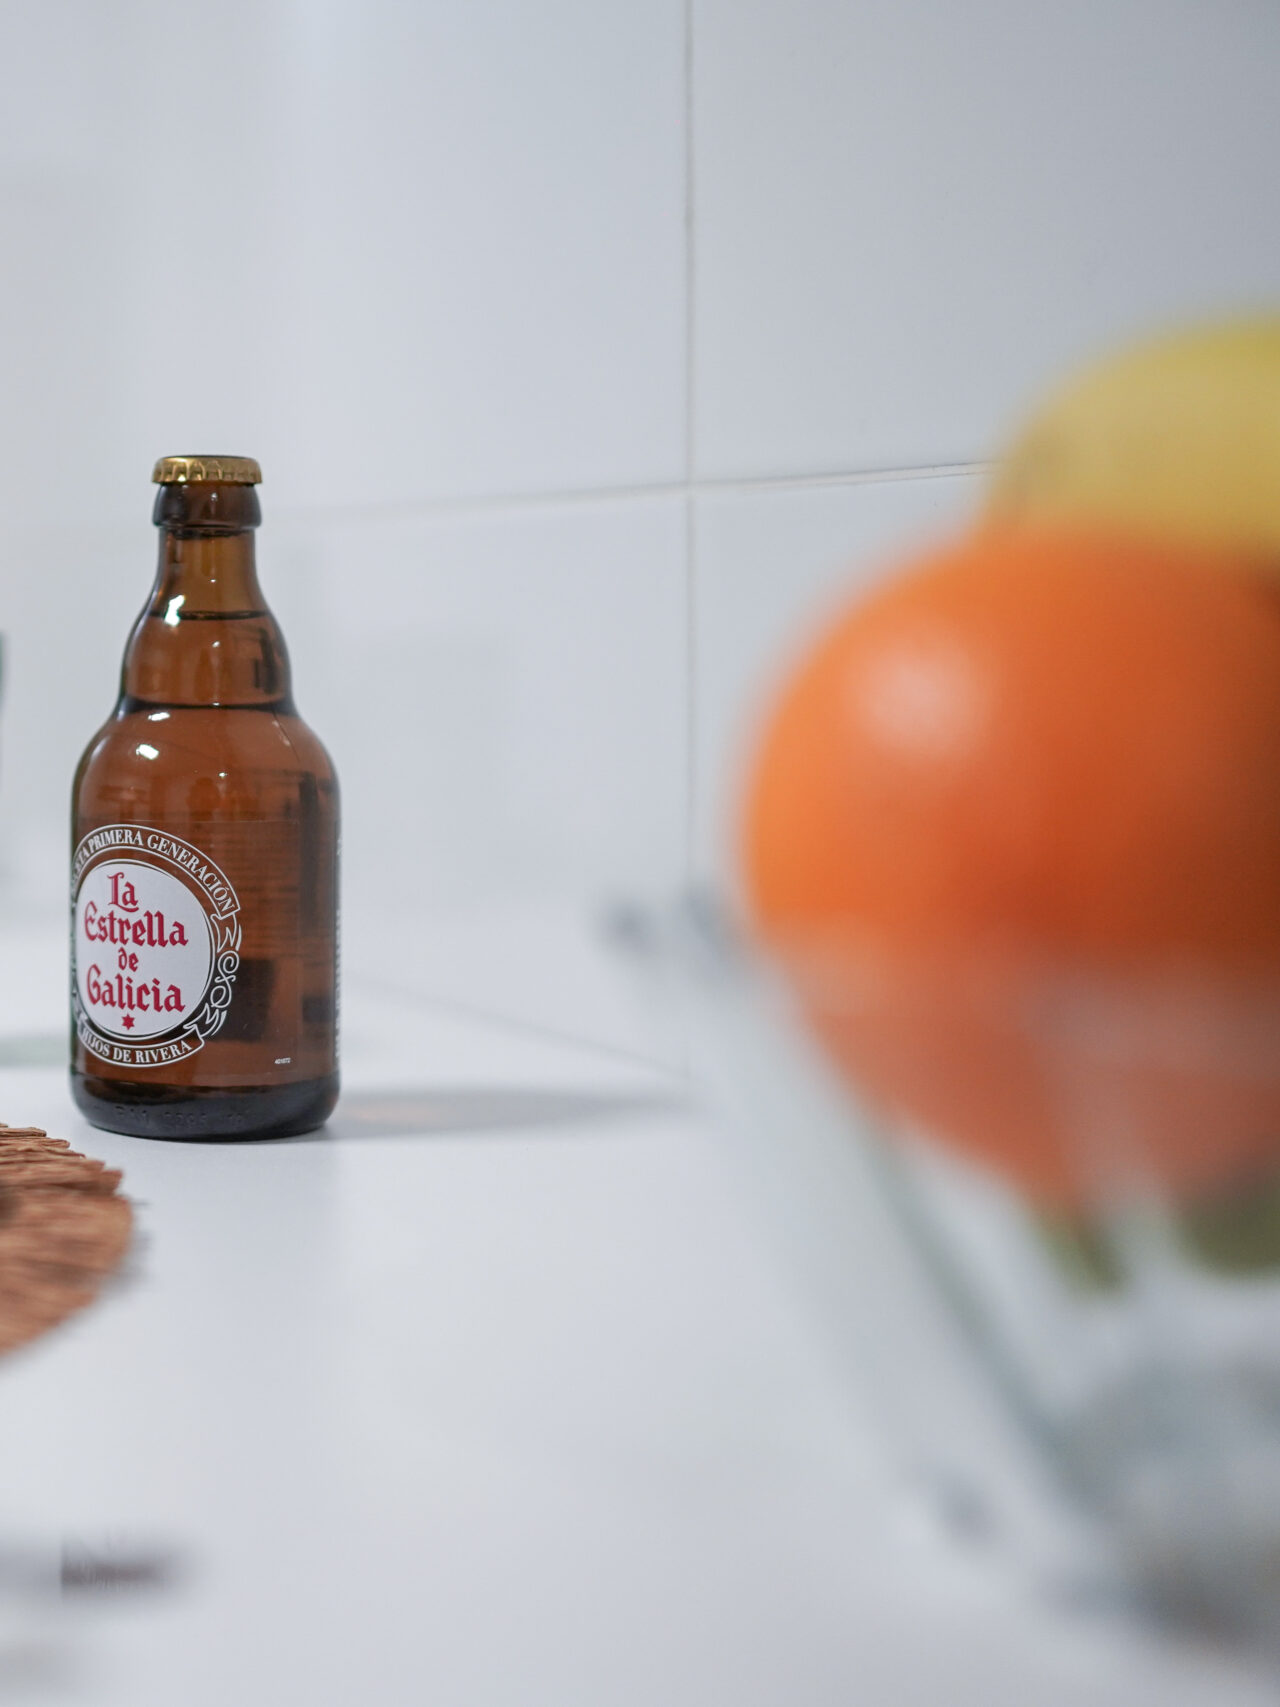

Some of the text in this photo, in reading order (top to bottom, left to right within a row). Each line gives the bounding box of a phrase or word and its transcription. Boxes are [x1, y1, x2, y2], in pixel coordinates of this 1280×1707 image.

[87, 829, 143, 854] PRIMERA
[147, 834, 235, 912] GENERACIÓN
[107, 872, 139, 913] La
[84, 900, 189, 947] Estrella
[118, 947, 139, 972] de
[87, 964, 186, 1012] Galicia
[112, 1047, 132, 1063] DE
[135, 1040, 193, 1064] RIVERA
